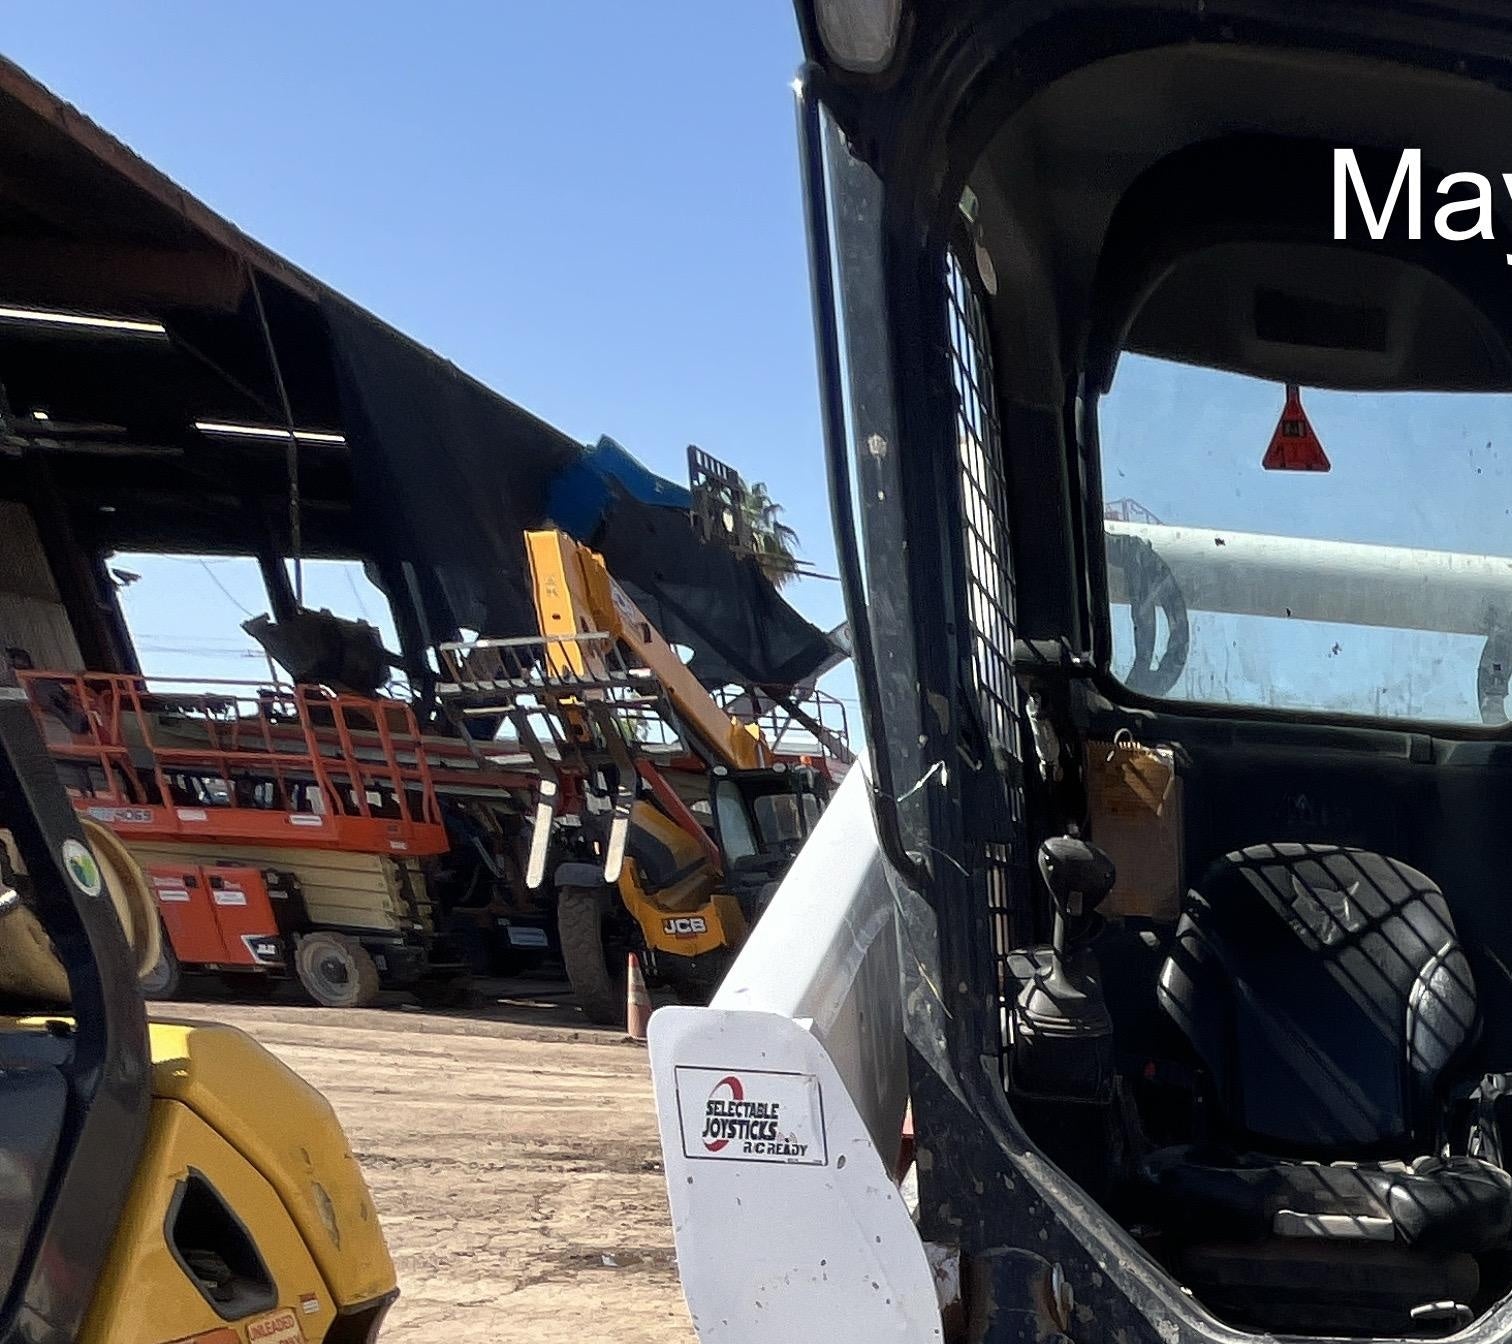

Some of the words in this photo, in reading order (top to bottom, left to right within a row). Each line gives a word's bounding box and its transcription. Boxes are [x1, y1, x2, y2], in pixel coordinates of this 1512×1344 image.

[664, 918, 706, 934] JCB
[705, 1099, 780, 1120] SELECTABLE
[702, 1119, 778, 1141] JOYSTICKS
[768, 1142, 809, 1157] READY
